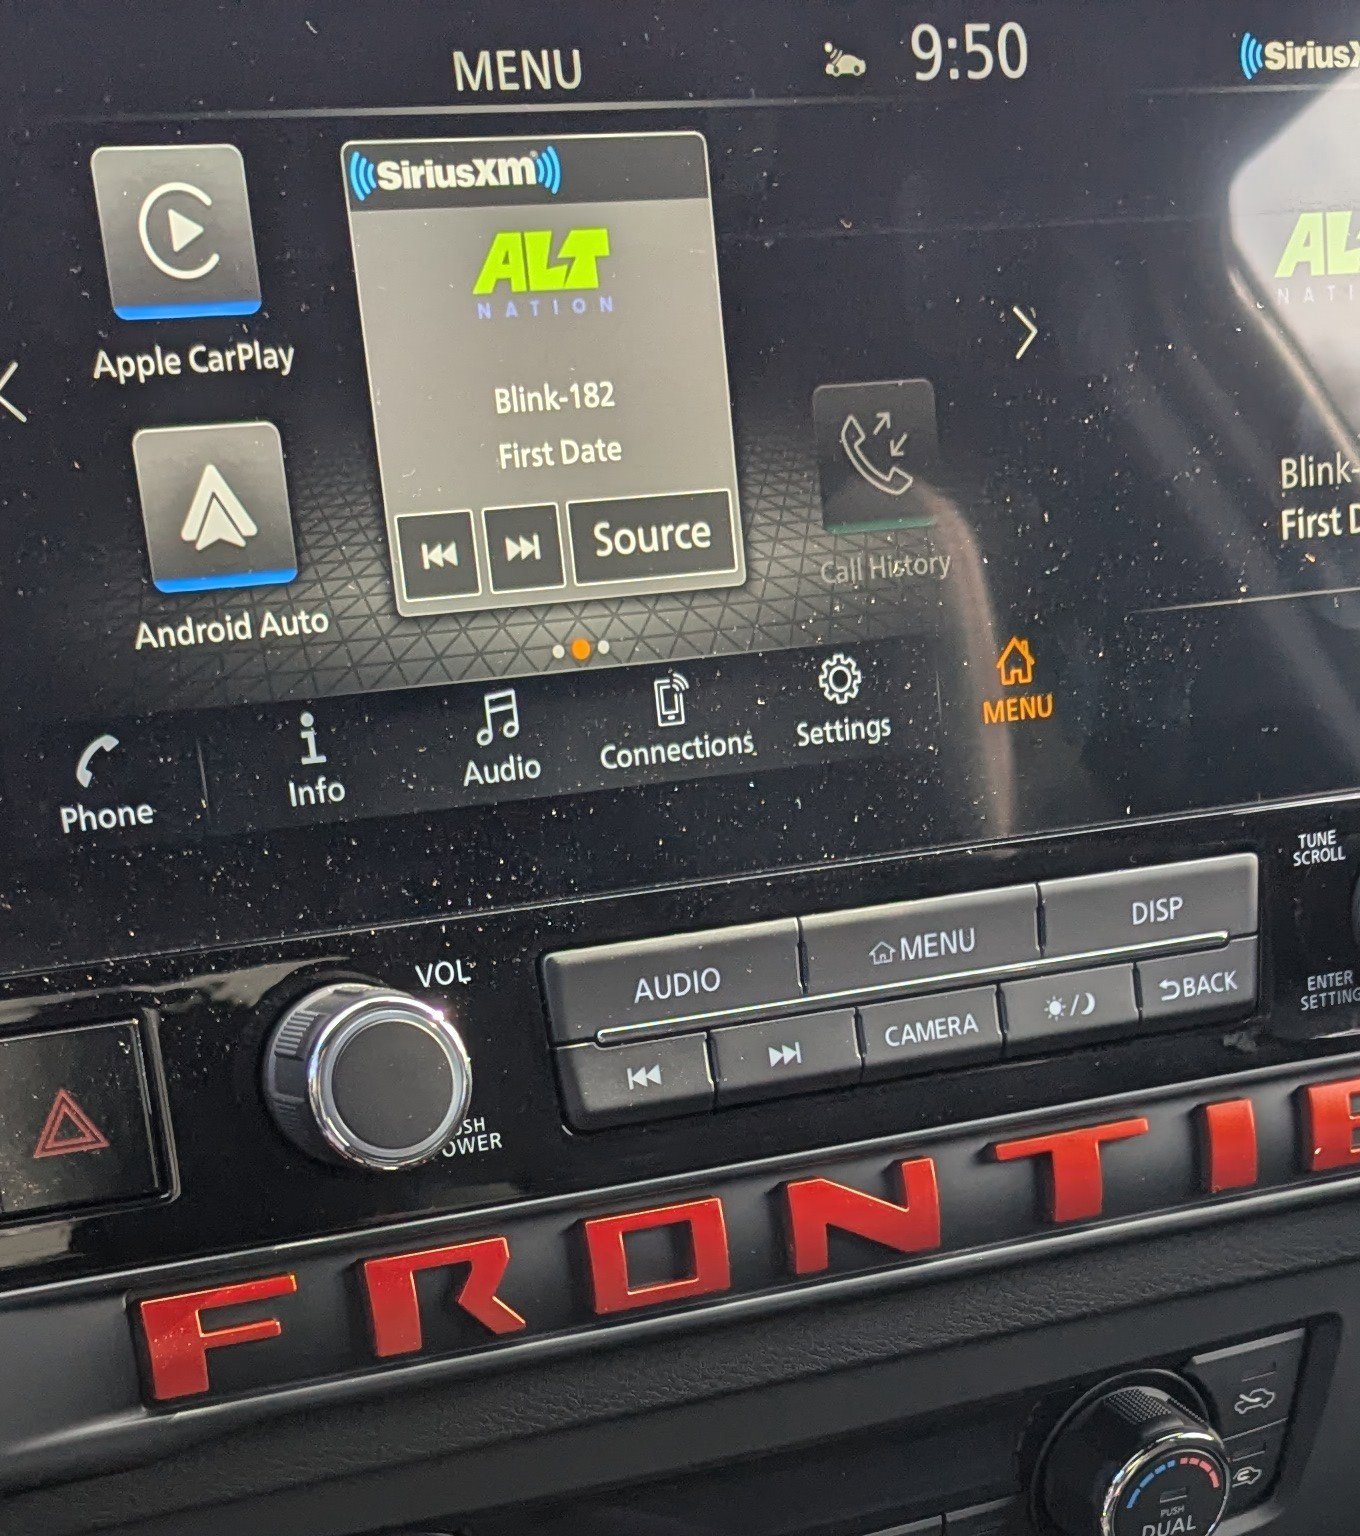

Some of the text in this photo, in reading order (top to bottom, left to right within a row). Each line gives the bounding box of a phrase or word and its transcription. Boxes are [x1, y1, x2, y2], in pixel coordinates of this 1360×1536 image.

[911, 22, 1028, 81] 9:50
[453, 49, 583, 92] MENU
[473, 228, 610, 294] ALT
[477, 296, 614, 320] NATION
[93, 341, 295, 385] Apple CarPlay
[495, 380, 616, 415] Blink-182
[499, 437, 622, 472] First Date
[594, 519, 712, 558] Source
[1281, 506, 1342, 541] First
[821, 552, 951, 585] Call History
[135, 609, 330, 650] Android Auto
[983, 694, 1054, 725] MENU
[796, 716, 891, 747] Settings
[600, 731, 754, 769] Connections
[463, 755, 541, 786] Audio
[289, 778, 345, 806] Info
[61, 802, 154, 833] Phone
[1298, 829, 1337, 849] TUNE
[1293, 846, 1346, 867] SCROLL
[1132, 896, 1183, 926] DISP
[900, 927, 976, 961] MENU
[416, 961, 471, 988] VOL
[635, 966, 721, 1004] AUDIO
[1184, 968, 1237, 998] BACK
[1307, 970, 1353, 992] ENTER
[885, 1012, 979, 1047] CAMERA
[455, 1116, 486, 1136] SH
[442, 1132, 503, 1158] OWER
[1160, 1504, 1185, 1518] PUSH
